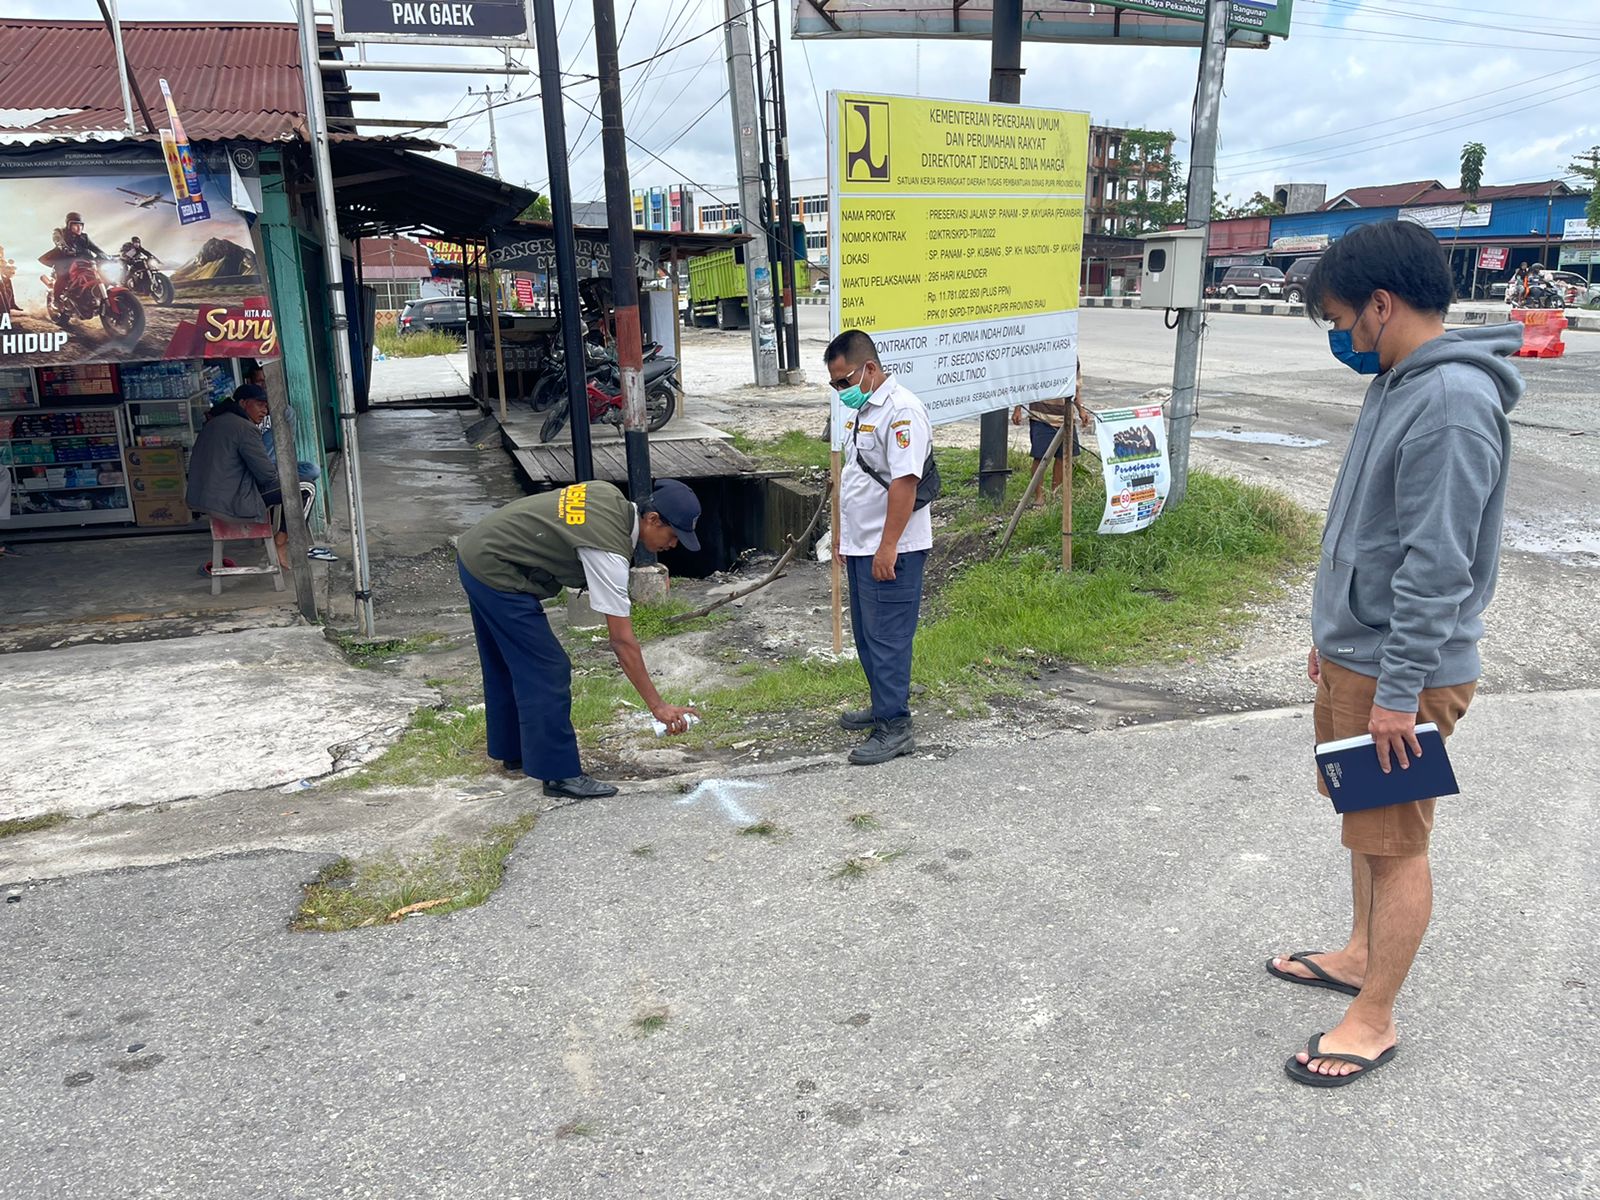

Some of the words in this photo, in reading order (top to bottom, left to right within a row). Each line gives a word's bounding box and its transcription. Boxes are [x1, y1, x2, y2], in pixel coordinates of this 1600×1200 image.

[392, 3, 427, 25] PAK
[430, 4, 474, 26] GAEK
[1165, 1, 1204, 15] Pekanbaru
[1233, 4, 1267, 17] Bangunan
[929, 108, 990, 126] KEMENTERIAN
[993, 113, 1036, 130] PEKERJAAN
[1037, 118, 1060, 131] UMUM
[945, 132, 964, 146] DAN
[967, 133, 1015, 149] PERUMAHAN
[1018, 136, 1046, 151] RAKYAT
[236, 154, 252, 165] 18+
[921, 153, 977, 169] DIREKTORAT
[979, 155, 1018, 170] JENDERAL
[1020, 157, 1038, 171] BINA
[1040, 159, 1065, 172] MARGA
[897, 176, 919, 186] SATUAN
[920, 177, 936, 186] KERJA
[937, 177, 966, 186] PERANGKAT
[967, 177, 986, 187] DAERAH
[987, 178, 1002, 187] TUGAS
[1003, 178, 1031, 187] PEMBANTUAN
[841, 210, 864, 221] NAMA
[865, 210, 896, 221] PROYEK
[929, 209, 968, 220] PRESERVASI
[969, 208, 988, 220] JALAN
[999, 208, 1018, 219] PANAM
[1031, 208, 1055, 218] KAYUARA
[842, 232, 872, 243] NOMOR
[872, 231, 907, 242] KONTRAK
[842, 253, 870, 265] LOKASI
[940, 248, 963, 260] PANAM
[977, 246, 1001, 258] KUBANG
[1024, 244, 1050, 255] NASUTION
[843, 277, 870, 288] WAKTU
[871, 274, 921, 287] PELAKSANAAN
[928, 271, 940, 282] 295
[940, 270, 955, 281] HARI
[956, 268, 987, 280] KALENDER
[842, 297, 865, 308] BIAYA
[980, 286, 997, 299] (PLUS
[998, 285, 1012, 297] PPN)
[244, 309, 259, 318] KITA
[842, 315, 876, 328] WILAYAH
[927, 310, 940, 320] PPK
[940, 309, 948, 319] 01
[948, 304, 975, 318] SKPD-TP
[975, 303, 993, 315] DINAS
[993, 302, 1009, 313] PUPR
[1009, 300, 1033, 312] PROVINSI
[1034, 299, 1046, 309] RIAU
[3, 331, 69, 354] HIDUP
[952, 330, 979, 345] KURNIA
[980, 327, 1001, 340] INDAH
[951, 350, 985, 367] SEECONS
[985, 348, 1000, 361] KSO
[1001, 346, 1011, 359] PT
[1011, 341, 1052, 358] DAKSINAPATI
[1052, 338, 1071, 350] KARSA
[936, 366, 987, 386] KONSULTINDO
[932, 399, 955, 411] DENGAN
[955, 395, 971, 408] BIAYA
[972, 390, 997, 402] SEBAGIAN
[1008, 384, 1025, 395] PAJAK
[1025, 381, 1040, 393] YANG
[1053, 376, 1069, 388] BAYAR
